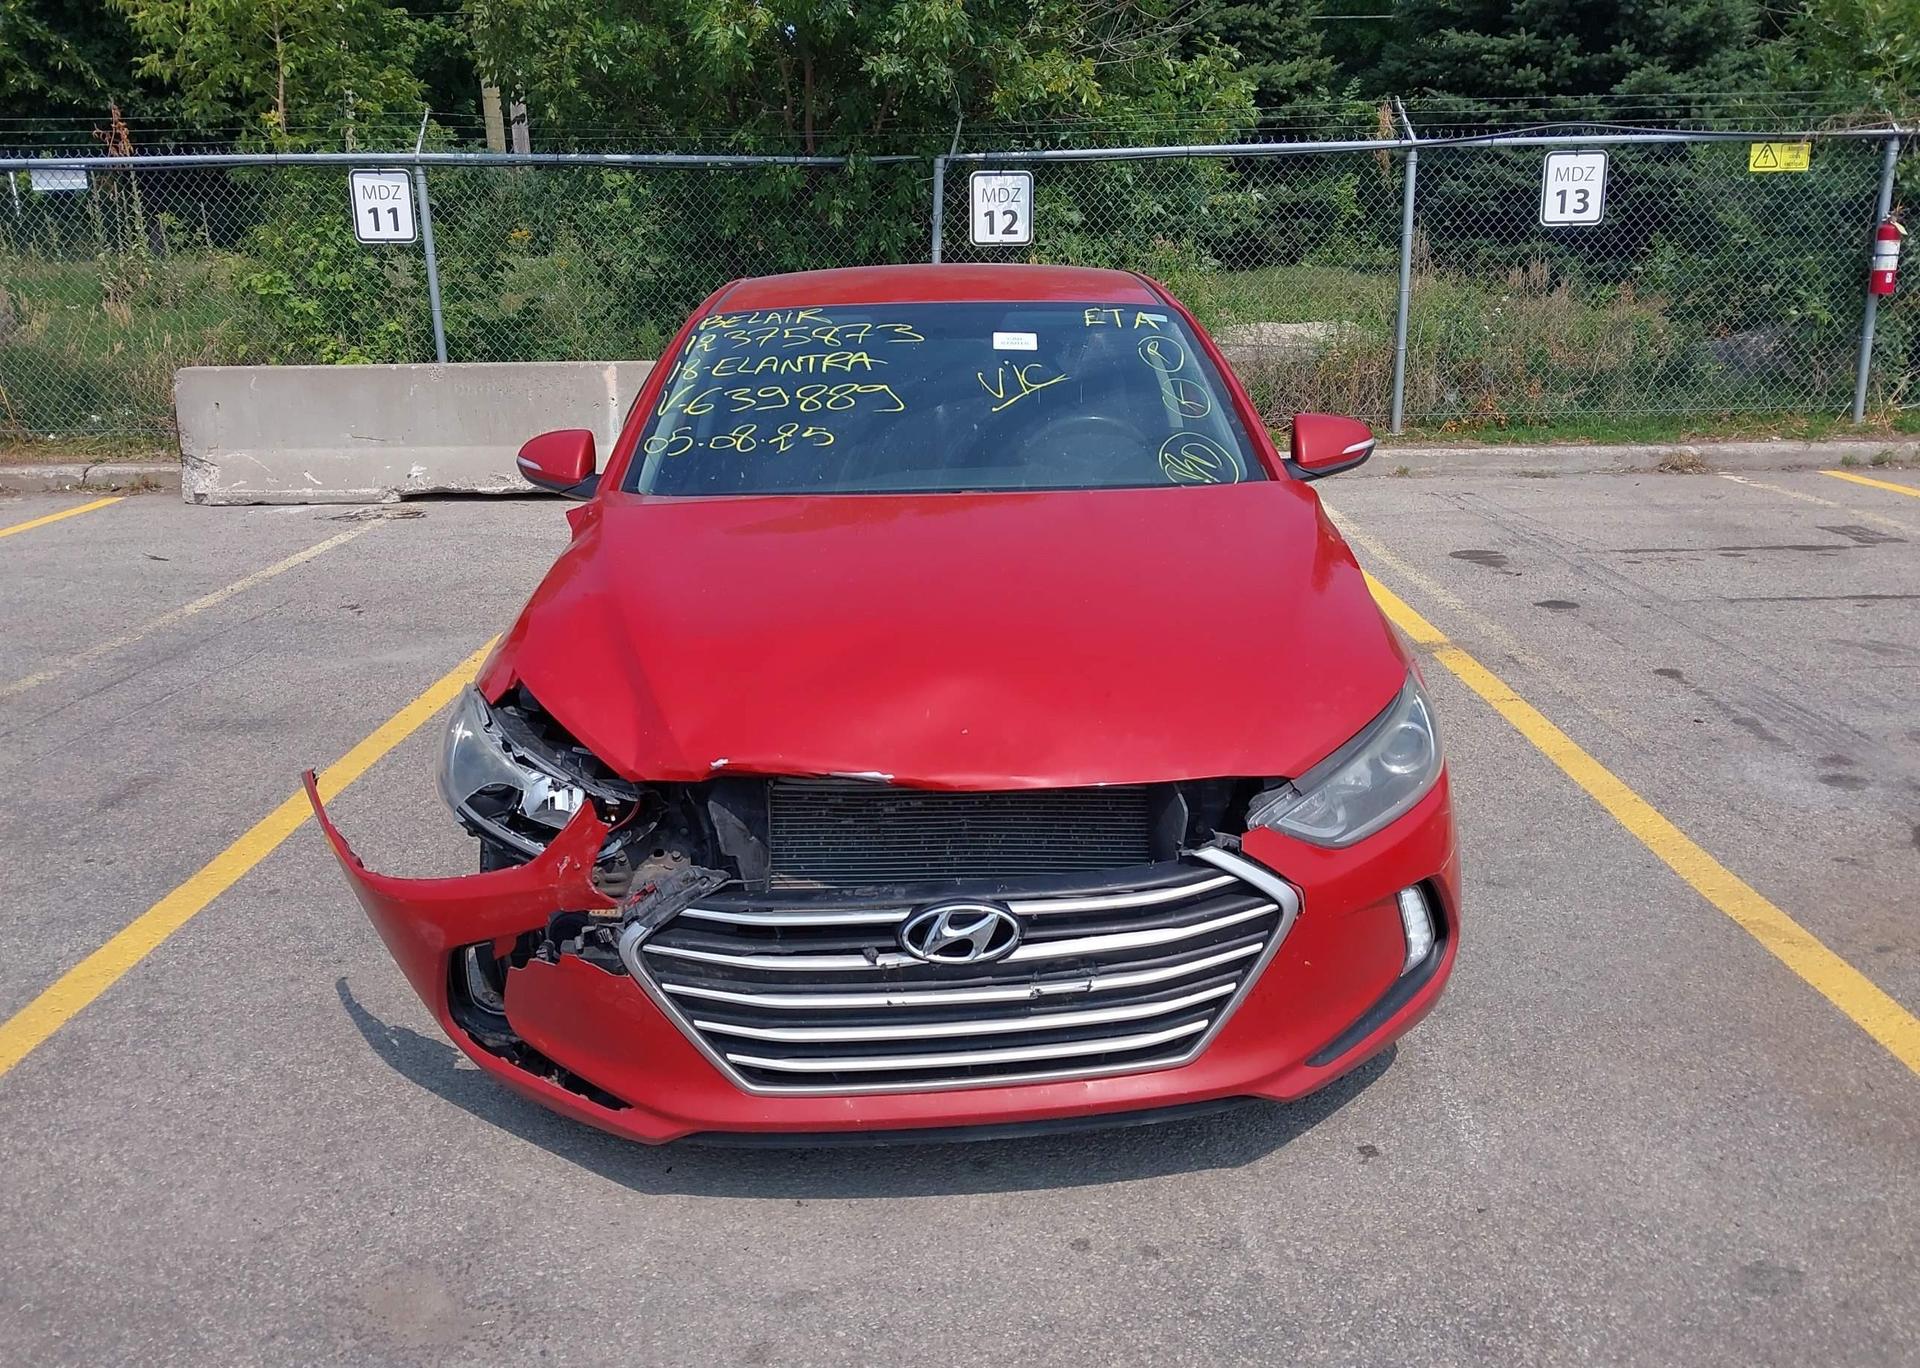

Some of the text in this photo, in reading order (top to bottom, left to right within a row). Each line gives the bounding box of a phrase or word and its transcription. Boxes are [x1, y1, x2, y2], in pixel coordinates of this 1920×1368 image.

[1555, 166, 1596, 182] MDZ
[362, 184, 402, 200] MDZ
[982, 187, 1021, 203] MDZ
[1556, 189, 1590, 214] 13
[367, 207, 399, 231] 11
[983, 210, 1018, 235] 12
[1085, 307, 1160, 331] ETA
